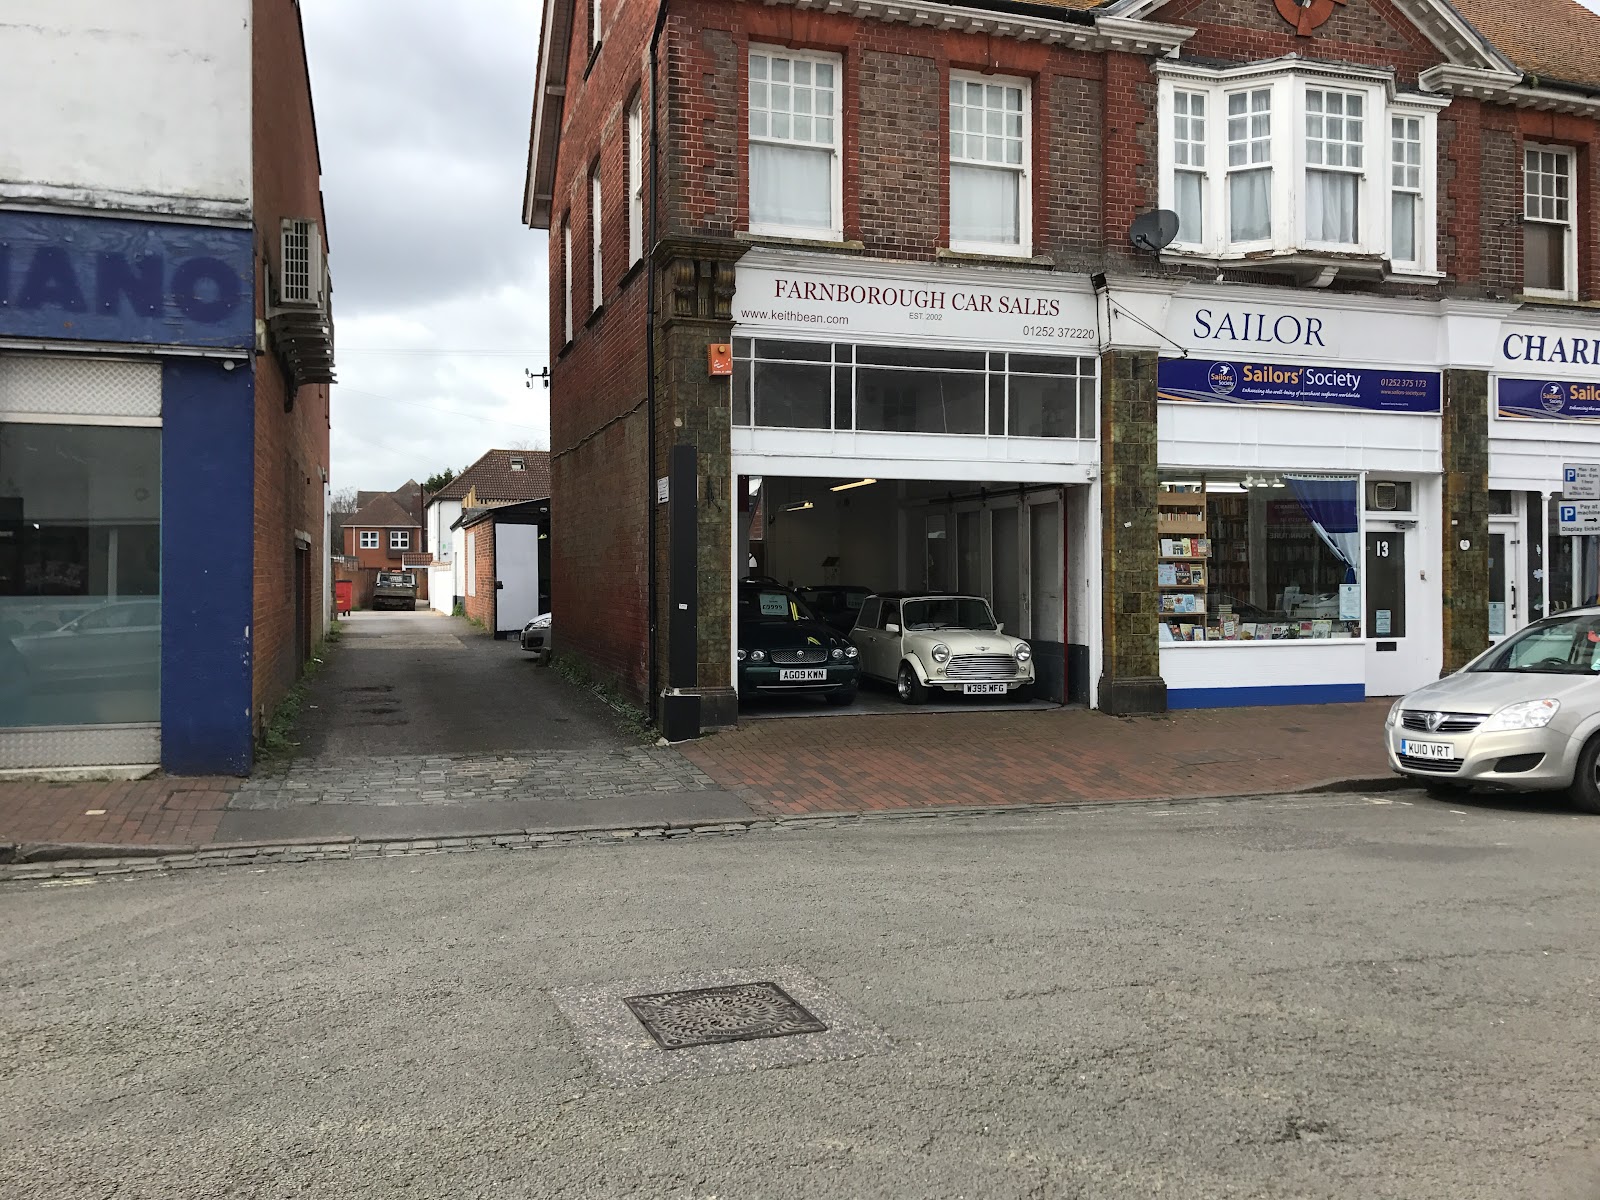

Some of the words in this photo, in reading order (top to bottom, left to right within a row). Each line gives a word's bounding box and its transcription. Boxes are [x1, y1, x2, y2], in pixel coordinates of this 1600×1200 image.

[774, 279, 946, 310] FARNBOROUGH
[951, 292, 994, 313] CAR
[998, 295, 1060, 317] SALES
[741, 309, 849, 325] www.keithbean.com
[926, 313, 943, 321] 2002
[1023, 325, 1054, 338] 01252
[1057, 328, 1095, 340] 372220
[1193, 308, 1326, 347] SAILOR
[1243, 365, 1303, 385] Sailors'
[1306, 368, 1361, 391] Society
[1380, 378, 1401, 387] 01252
[1401, 379, 1414, 387] 375
[1415, 379, 1427, 388] 173
[1567, 470, 1575, 481] P
[1564, 508, 1574, 521] P
[1377, 540, 1389, 557] 13
[783, 671, 806, 679] AG09
[807, 670, 824, 679] KWN
[967, 684, 987, 693] W395
[989, 684, 1004, 693] MFG
[1409, 742, 1428, 755] KU10
[1431, 744, 1450, 757] VRT
